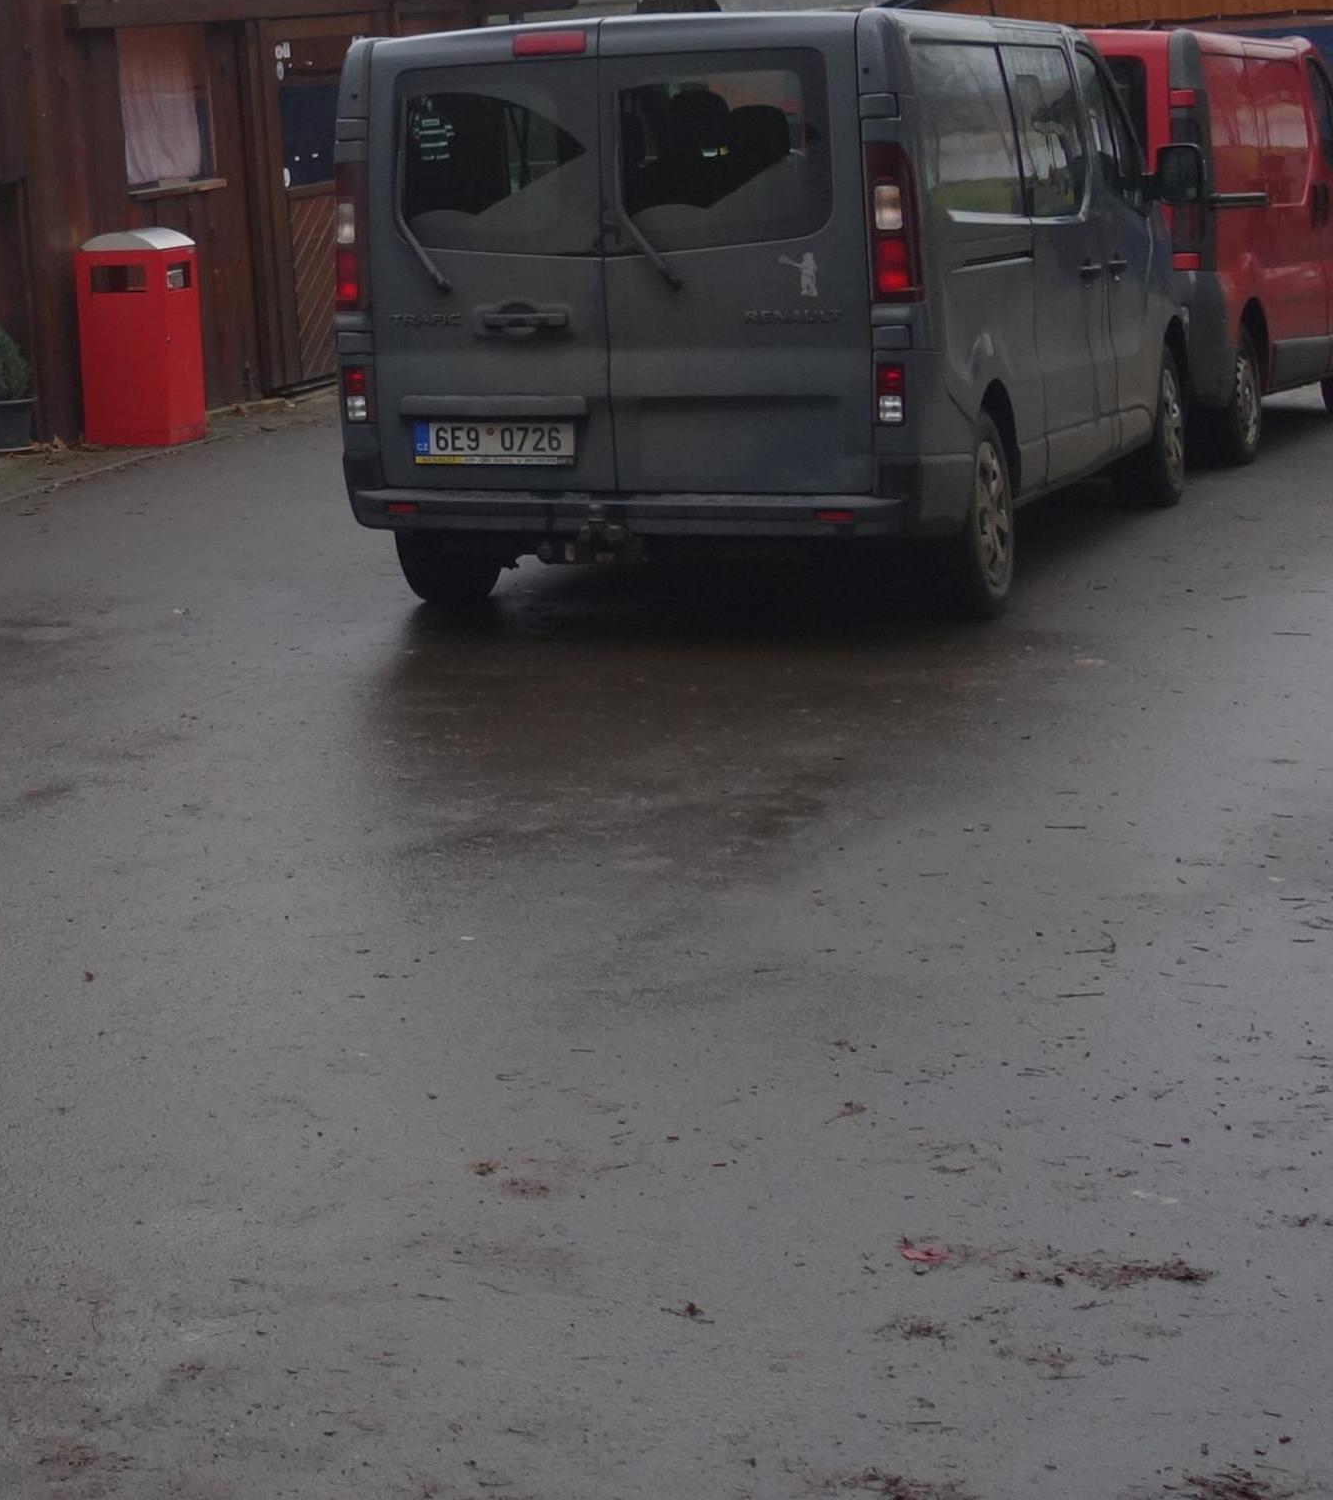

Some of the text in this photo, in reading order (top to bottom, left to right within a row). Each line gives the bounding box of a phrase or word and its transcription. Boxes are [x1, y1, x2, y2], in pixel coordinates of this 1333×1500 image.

[390, 313, 461, 327] TRAFIC
[742, 309, 843, 324] RENAULT
[416, 426, 562, 452] CZ 6E9 0726
